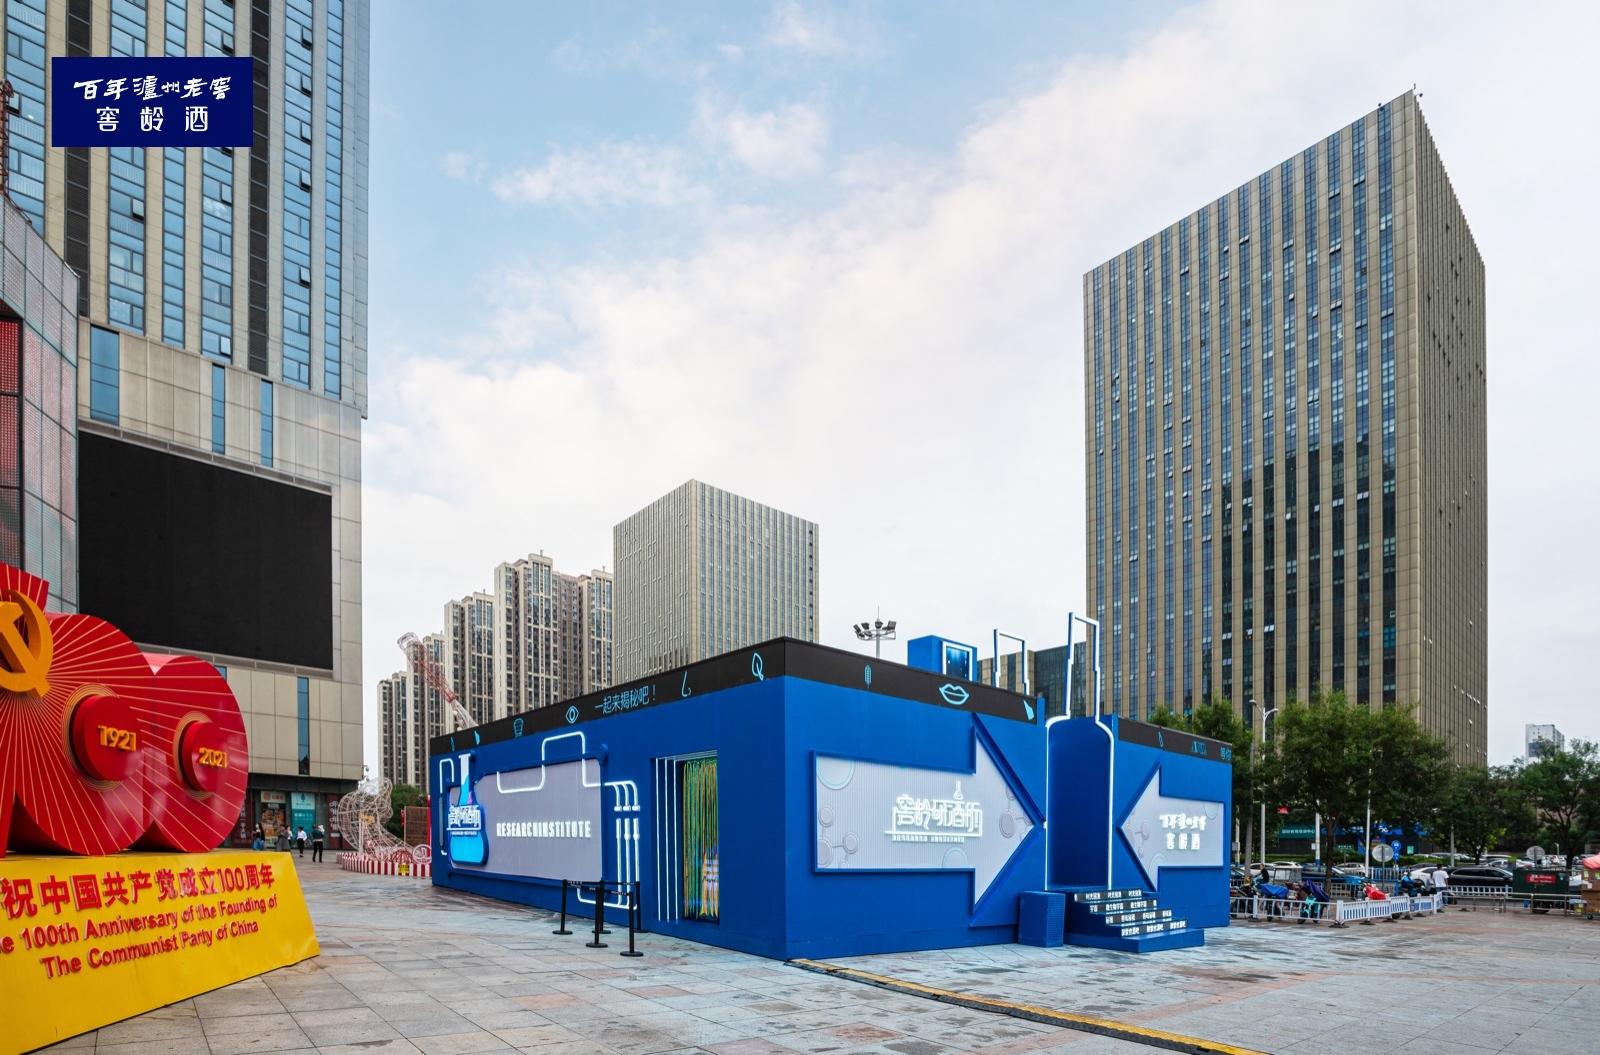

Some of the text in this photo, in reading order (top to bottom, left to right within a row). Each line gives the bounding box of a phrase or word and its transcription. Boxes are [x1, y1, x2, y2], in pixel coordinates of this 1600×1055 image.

[98, 725, 137, 752] 1921
[199, 747, 228, 768] 2021
[0, 863, 275, 920] 祝中国共产党成立100周年
[20, 922, 79, 950] 100th
[83, 911, 178, 941] Anniversary
[181, 904, 195, 924] of
[196, 903, 217, 921] the
[218, 896, 267, 917] Founding
[268, 893, 278, 910] of
[41, 919, 259, 979] The Communist Party of China
